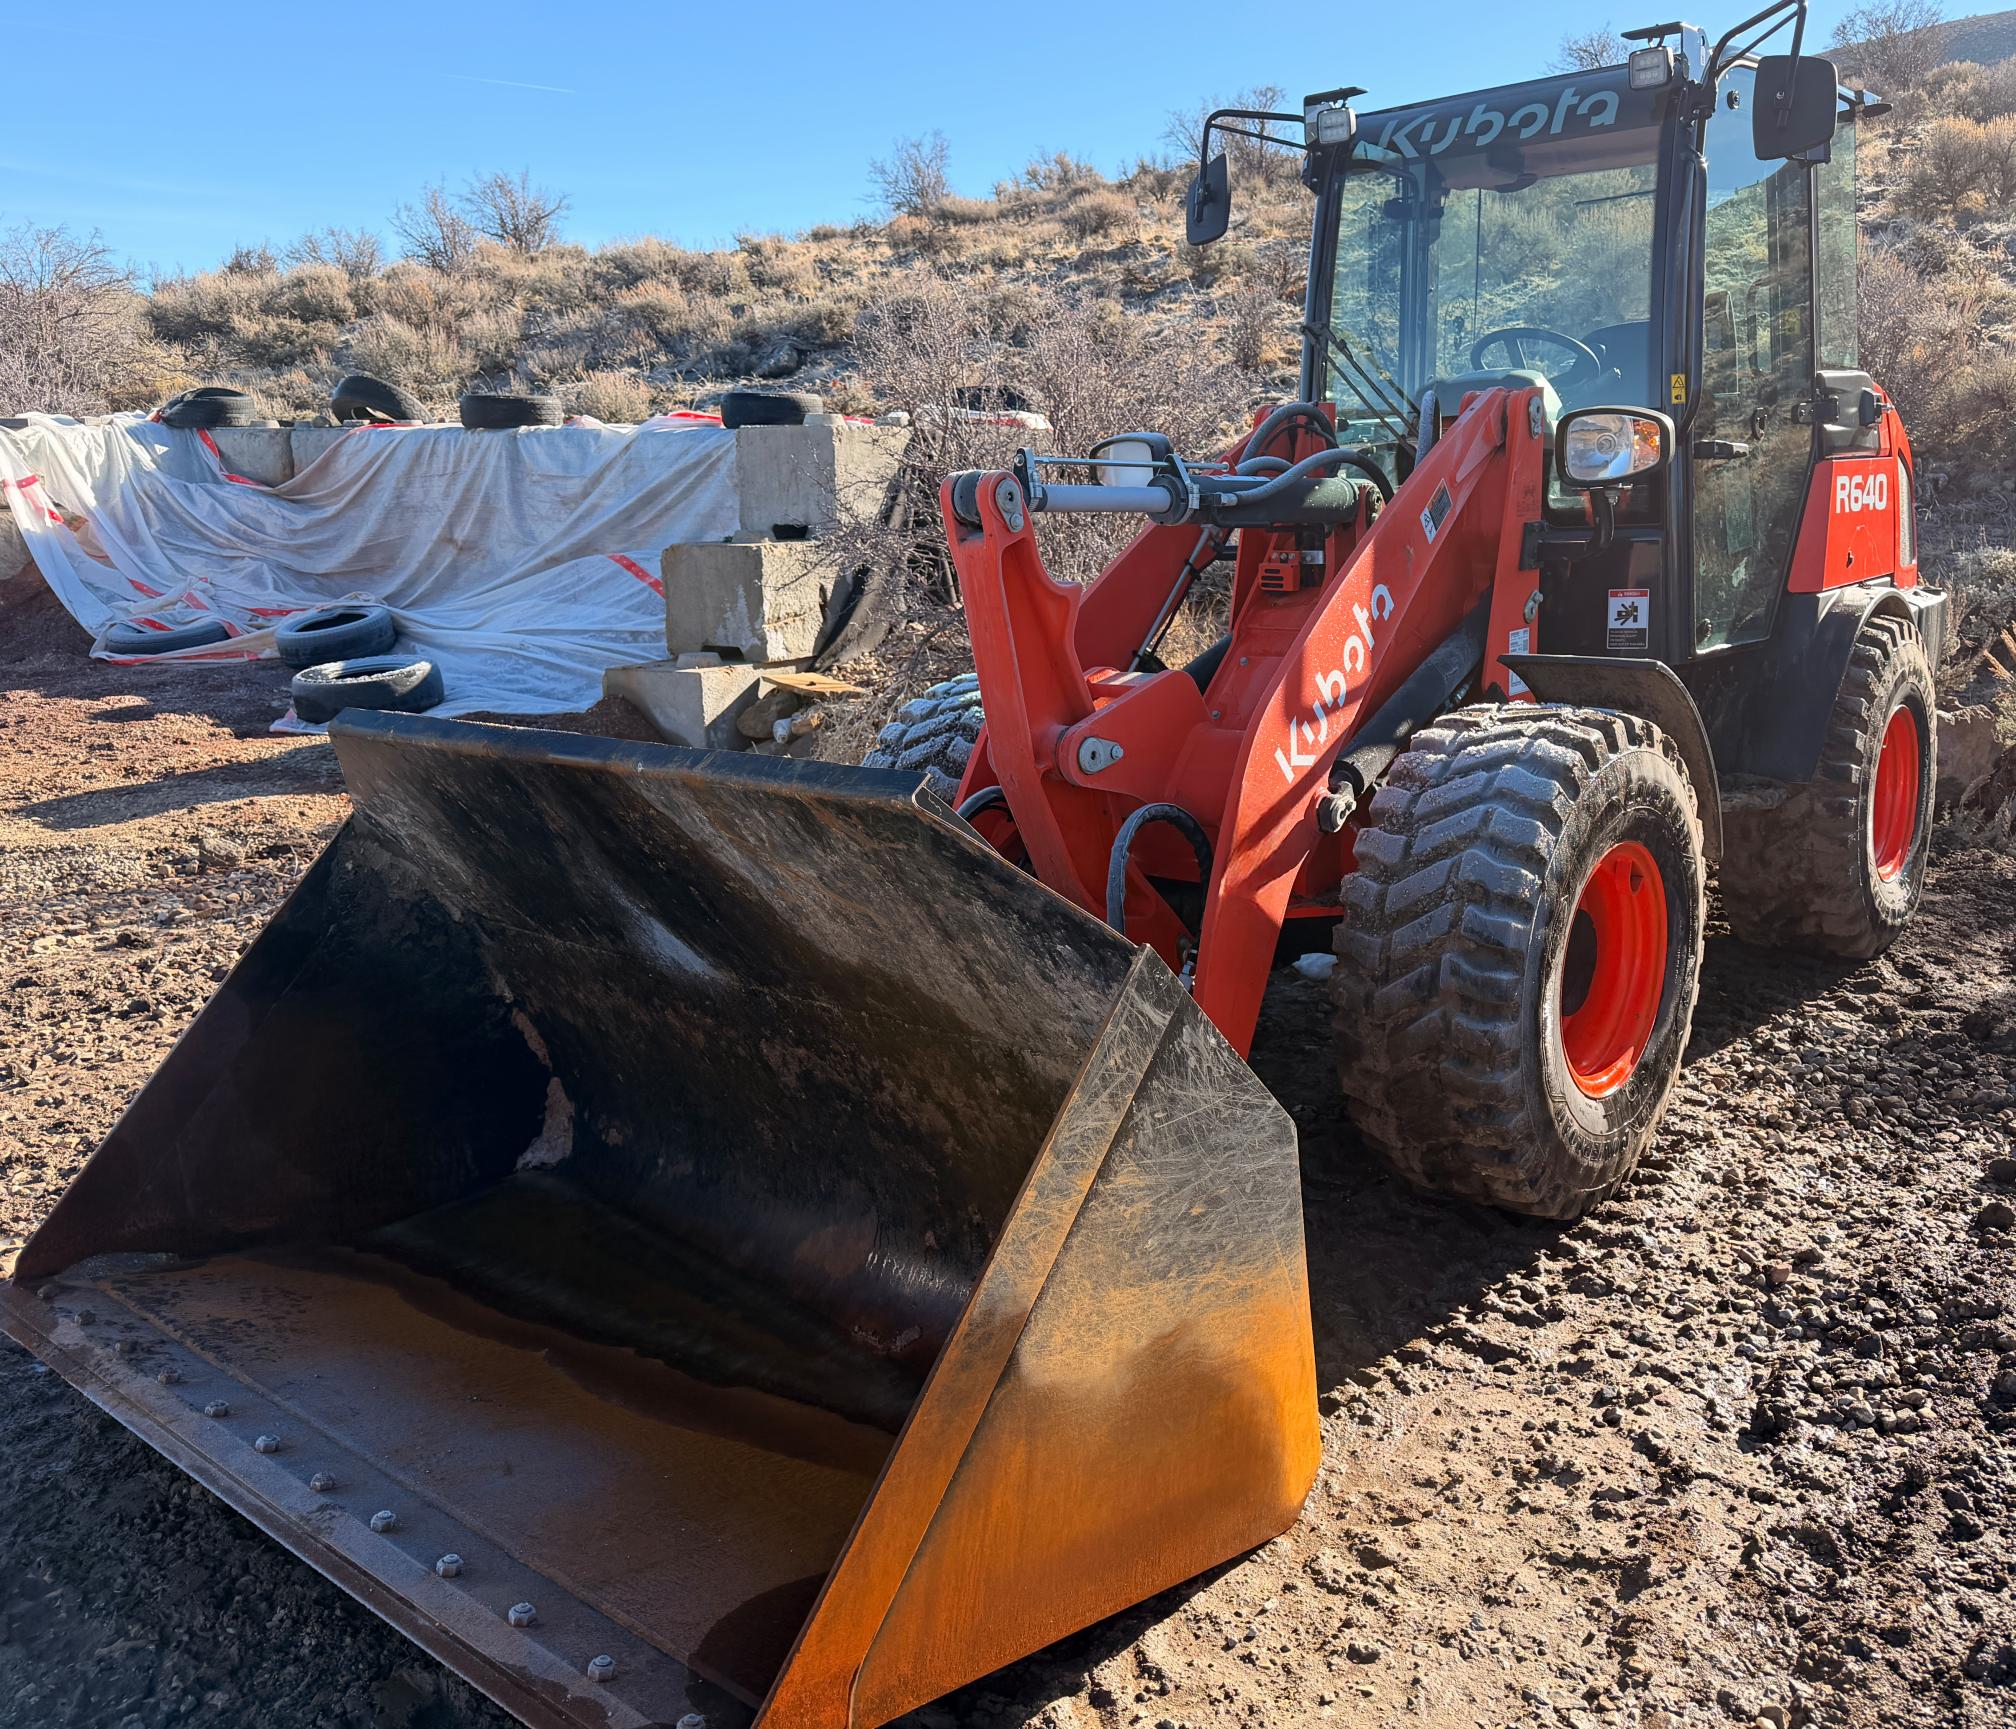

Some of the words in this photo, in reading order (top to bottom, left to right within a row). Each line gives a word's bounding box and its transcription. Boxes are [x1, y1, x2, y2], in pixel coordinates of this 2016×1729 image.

[1378, 87, 1620, 158] Kubota
[1836, 473, 1888, 513] R640
[1274, 583, 1395, 784] Kubota
